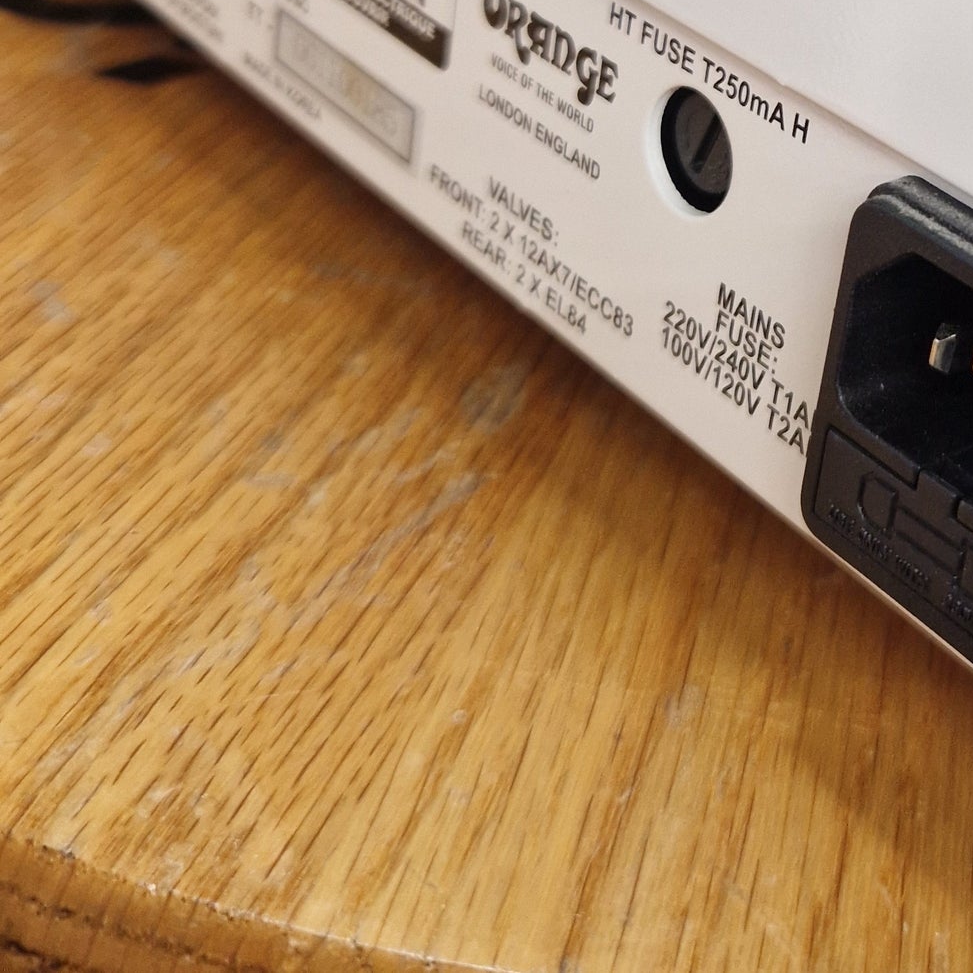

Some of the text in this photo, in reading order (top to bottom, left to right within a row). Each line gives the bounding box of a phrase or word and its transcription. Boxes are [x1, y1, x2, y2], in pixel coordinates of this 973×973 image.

[491, 52, 595, 134] VOICE OF THE WORLD
[609, 1, 811, 145] HT FUSE T250mA H
[479, 83, 601, 181] LONDON ENGLAND
[430, 163, 635, 337] FRONT: 2 X 12AX7/ECC83
[489, 176, 560, 247] VALVES:
[461, 220, 588, 335] REAR: 2 X EL84
[717, 282, 786, 350] MAINS
[662, 299, 809, 430] 220V/240V T1A
[662, 326, 805, 455] 100V/120V T2A
[715, 309, 779, 375] FUSE:
